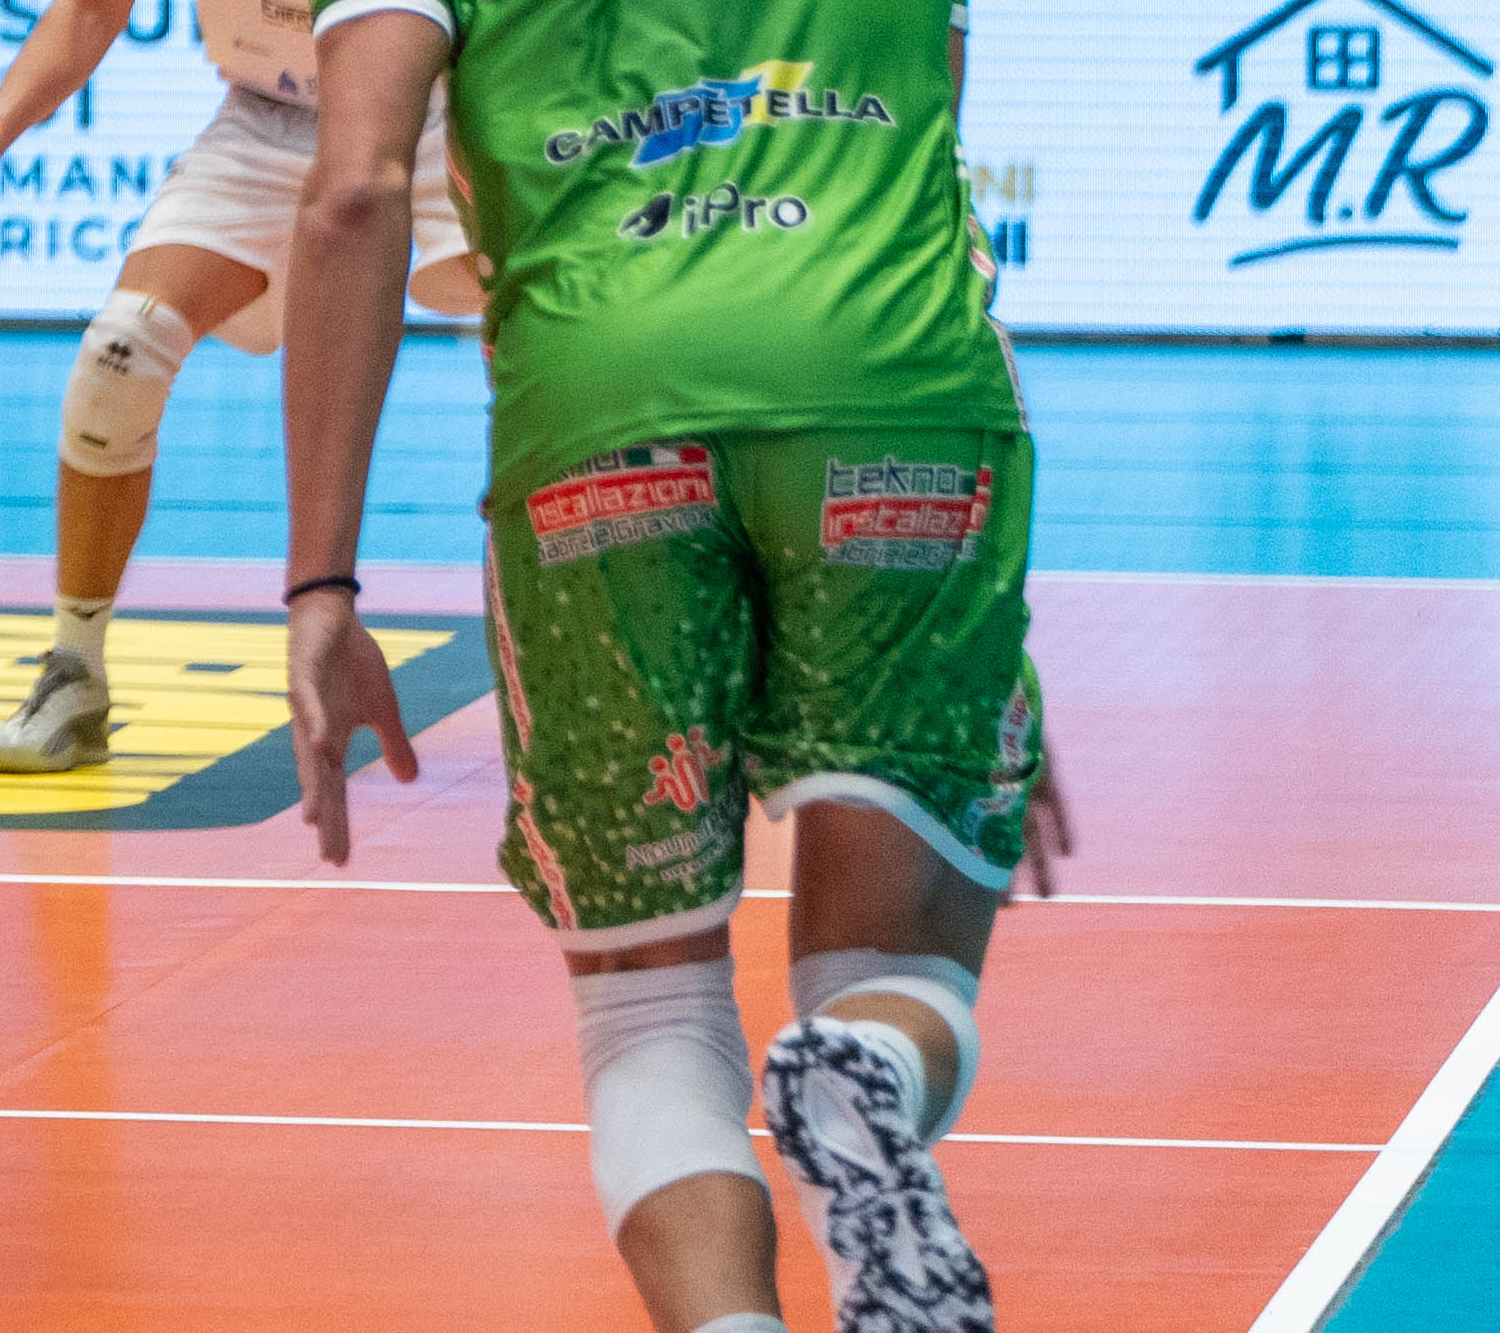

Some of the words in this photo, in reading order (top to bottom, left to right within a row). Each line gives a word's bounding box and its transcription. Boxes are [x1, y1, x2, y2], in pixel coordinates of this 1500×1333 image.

[544, 88, 898, 164] CAMPETELLA
[1190, 85, 1491, 227] M.R
[681, 180, 809, 238] iPro
